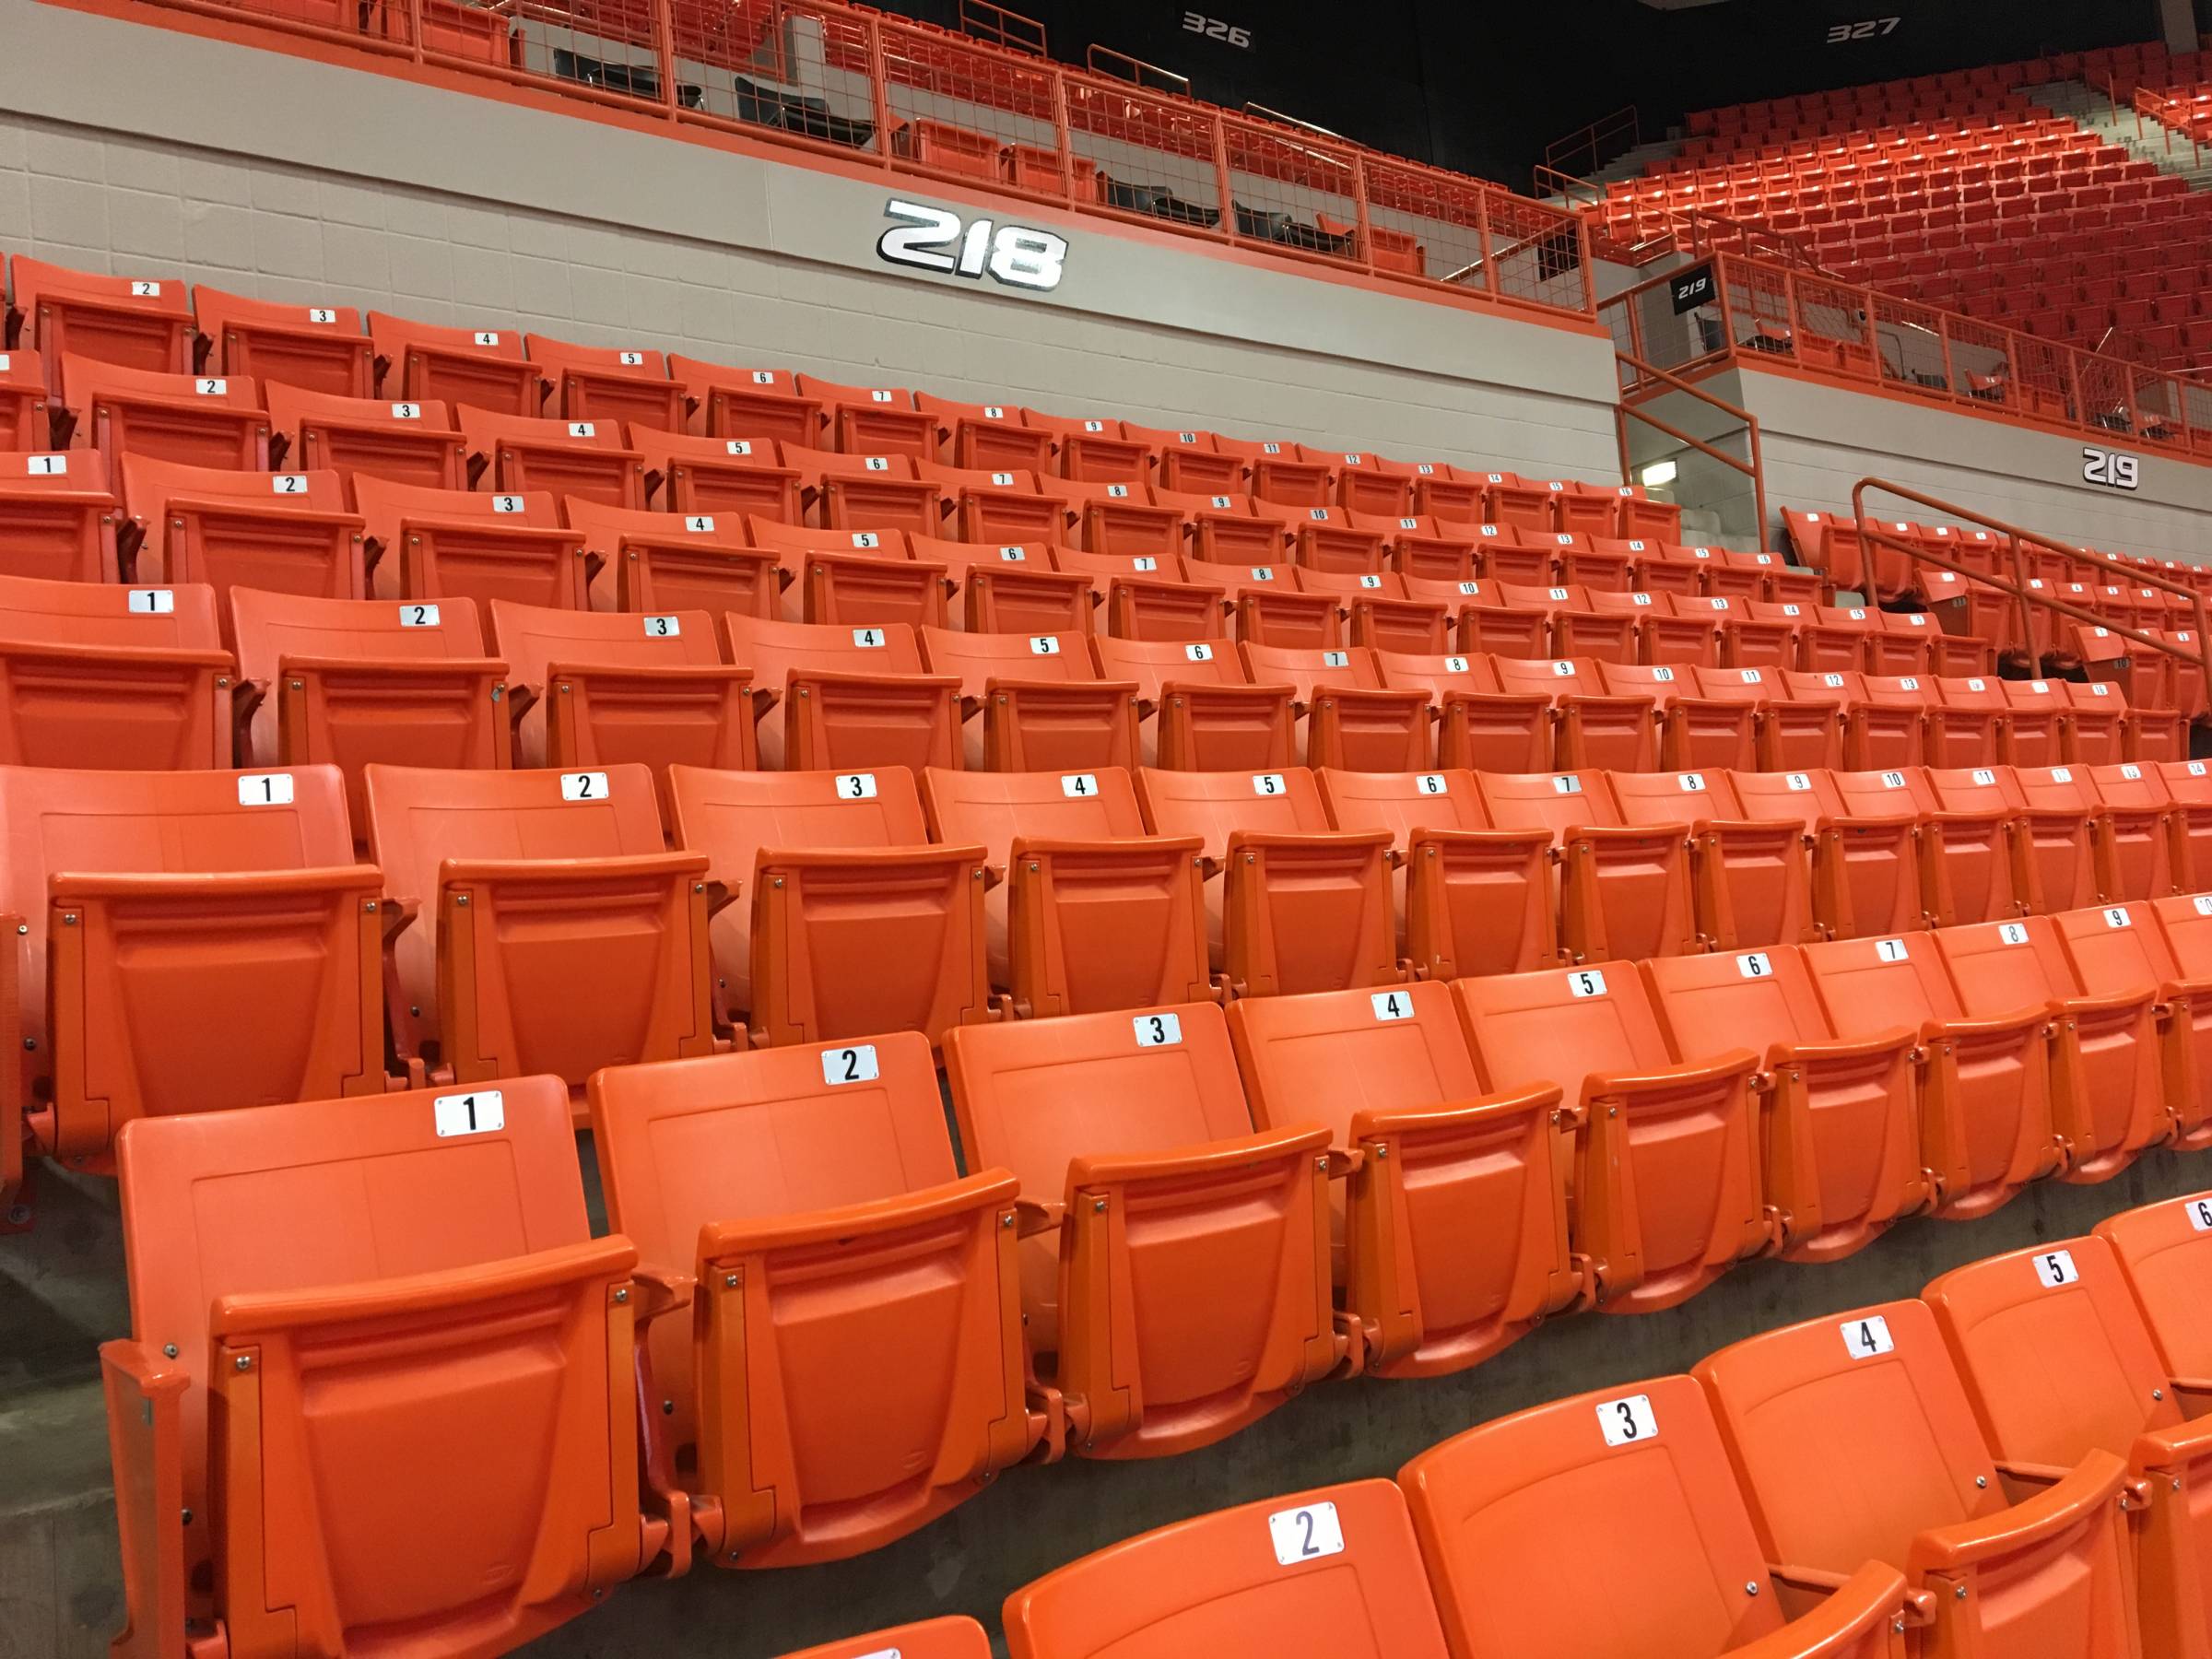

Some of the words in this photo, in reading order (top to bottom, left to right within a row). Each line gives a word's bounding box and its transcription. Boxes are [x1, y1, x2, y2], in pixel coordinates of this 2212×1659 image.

[1182, 10, 1252, 49] 326
[1826, 17, 1901, 44] 327
[876, 195, 1070, 293] 218
[142, 283, 150, 295] 2
[1677, 276, 1707, 300] 219
[319, 311, 326, 322] 3
[483, 334, 490, 345] 4
[628, 353, 635, 364] 5
[759, 372, 767, 383] 6
[207, 380, 216, 394] 2
[879, 391, 884, 401] 7
[402, 405, 410, 418] 3
[991, 407, 997, 418] 8
[578, 424, 585, 436] 4
[1090, 422, 1098, 430] 9
[1183, 433, 1194, 442] 10
[735, 442, 743, 453] 5
[1267, 444, 1277, 453] 11
[44, 457, 51, 473] 1
[873, 458, 880, 469] 6
[1348, 455, 1358, 464] 12
[1421, 465, 1430, 474] 13
[2082, 446, 2139, 491] 219
[286, 477, 296, 492] 2
[999, 474, 1005, 484] 7
[1114, 486, 1121, 496] 8
[504, 497, 513, 512] 3
[1218, 498, 1225, 507] 9
[1313, 510, 1325, 519] 10
[696, 518, 704, 531] 4
[1404, 519, 1414, 528] 11
[1484, 525, 1494, 535] 12
[861, 534, 870, 547] 5
[1560, 535, 1571, 544] 13
[1008, 547, 1017, 560] 6
[1141, 559, 1147, 570] 7
[1258, 569, 1266, 580] 8
[1367, 576, 1374, 587] 9
[1463, 582, 1475, 594] 10
[1554, 589, 1564, 598] 11
[1637, 594, 1648, 604] 12
[147, 592, 155, 611] 1
[1714, 599, 1725, 609] 13
[414, 606, 426, 625] 2
[1786, 606, 1797, 615] 14
[1853, 610, 1863, 619] 15
[656, 618, 667, 635] 3
[865, 630, 874, 645] 4
[1040, 638, 1050, 653] 5
[1194, 645, 1204, 659] 6
[1331, 653, 1338, 665] 7
[1453, 658, 1461, 671] 8
[2117, 658, 2127, 668] 10
[1560, 663, 1569, 675] 9
[1657, 668, 1670, 680] 10
[1746, 671, 1757, 680] 11
[1829, 675, 1840, 686] 12
[1903, 678, 1915, 689] 13
[2190, 764, 2203, 774] 14
[1688, 775, 1697, 789] 8
[1794, 775, 1803, 788] 9
[1887, 773, 1901, 785] 10
[1978, 771, 1992, 782] 11
[262, 777, 271, 802] 1
[578, 775, 592, 798] 2
[850, 776, 863, 797] 3
[1075, 777, 1086, 794] 4
[1264, 776, 1275, 794] 5
[1427, 776, 1437, 793] 6
[1561, 777, 1571, 792] 7
[2112, 910, 2123, 925] 9
[2008, 925, 2018, 942] 8
[1886, 942, 1895, 959] 7
[1748, 956, 1760, 975] 6
[1580, 973, 1594, 994] 5
[1387, 994, 1400, 1018] 4
[1149, 1017, 1165, 1043] 3
[841, 1050, 860, 1081] 2
[463, 1097, 477, 1131] 1
[2198, 1202, 2212, 1227] 6
[2046, 1255, 2065, 1283] 5
[1861, 1322, 1877, 1352] 4
[1617, 1402, 1637, 1439] 3
[1296, 1511, 1320, 1556] 2
